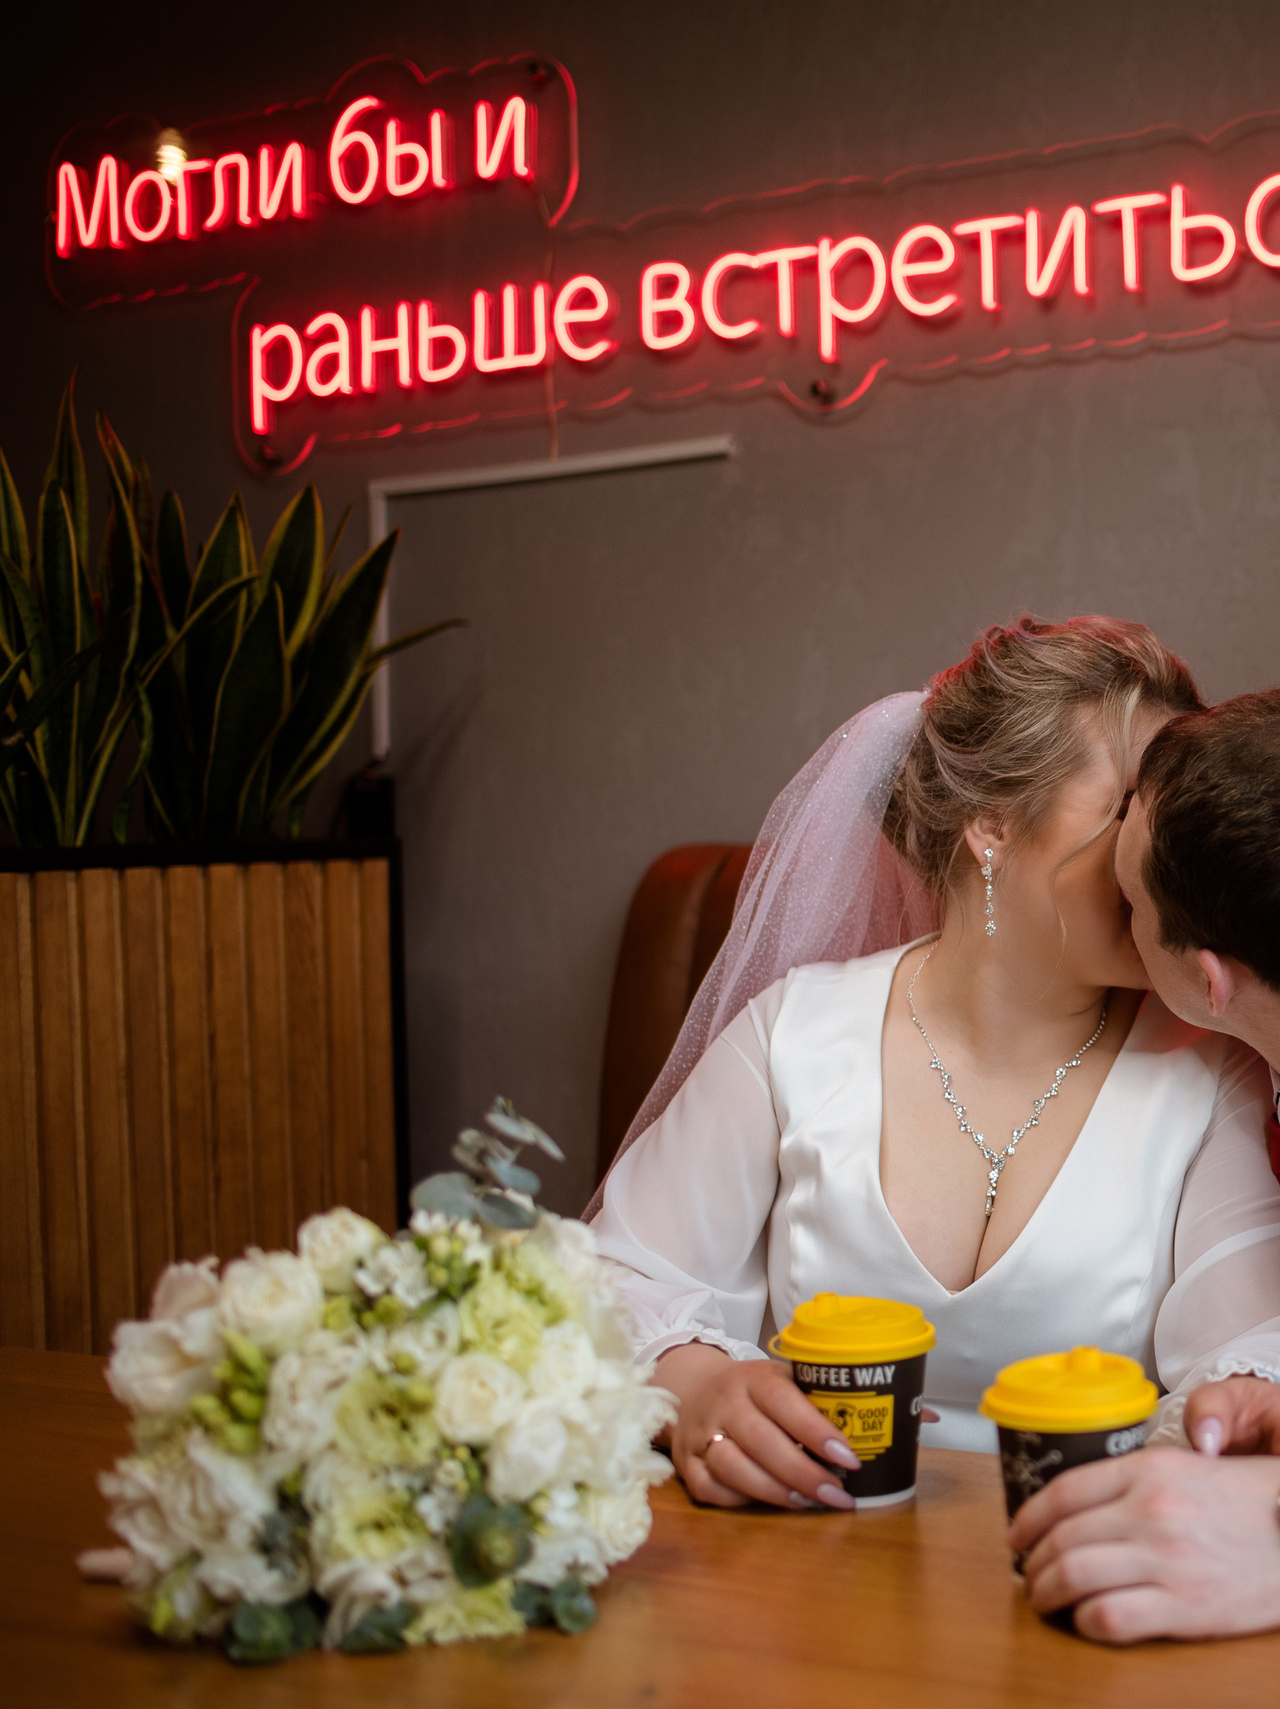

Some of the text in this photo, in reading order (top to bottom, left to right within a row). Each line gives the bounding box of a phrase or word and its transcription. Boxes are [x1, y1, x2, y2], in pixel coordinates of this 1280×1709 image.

[56, 96, 532, 258] Могли бы и
[249, 274, 612, 434] раньше
[797, 1363, 896, 1387] COFFEE WAY
[858, 1406, 889, 1419] GOOD
[862, 1418, 885, 1432] DAY
